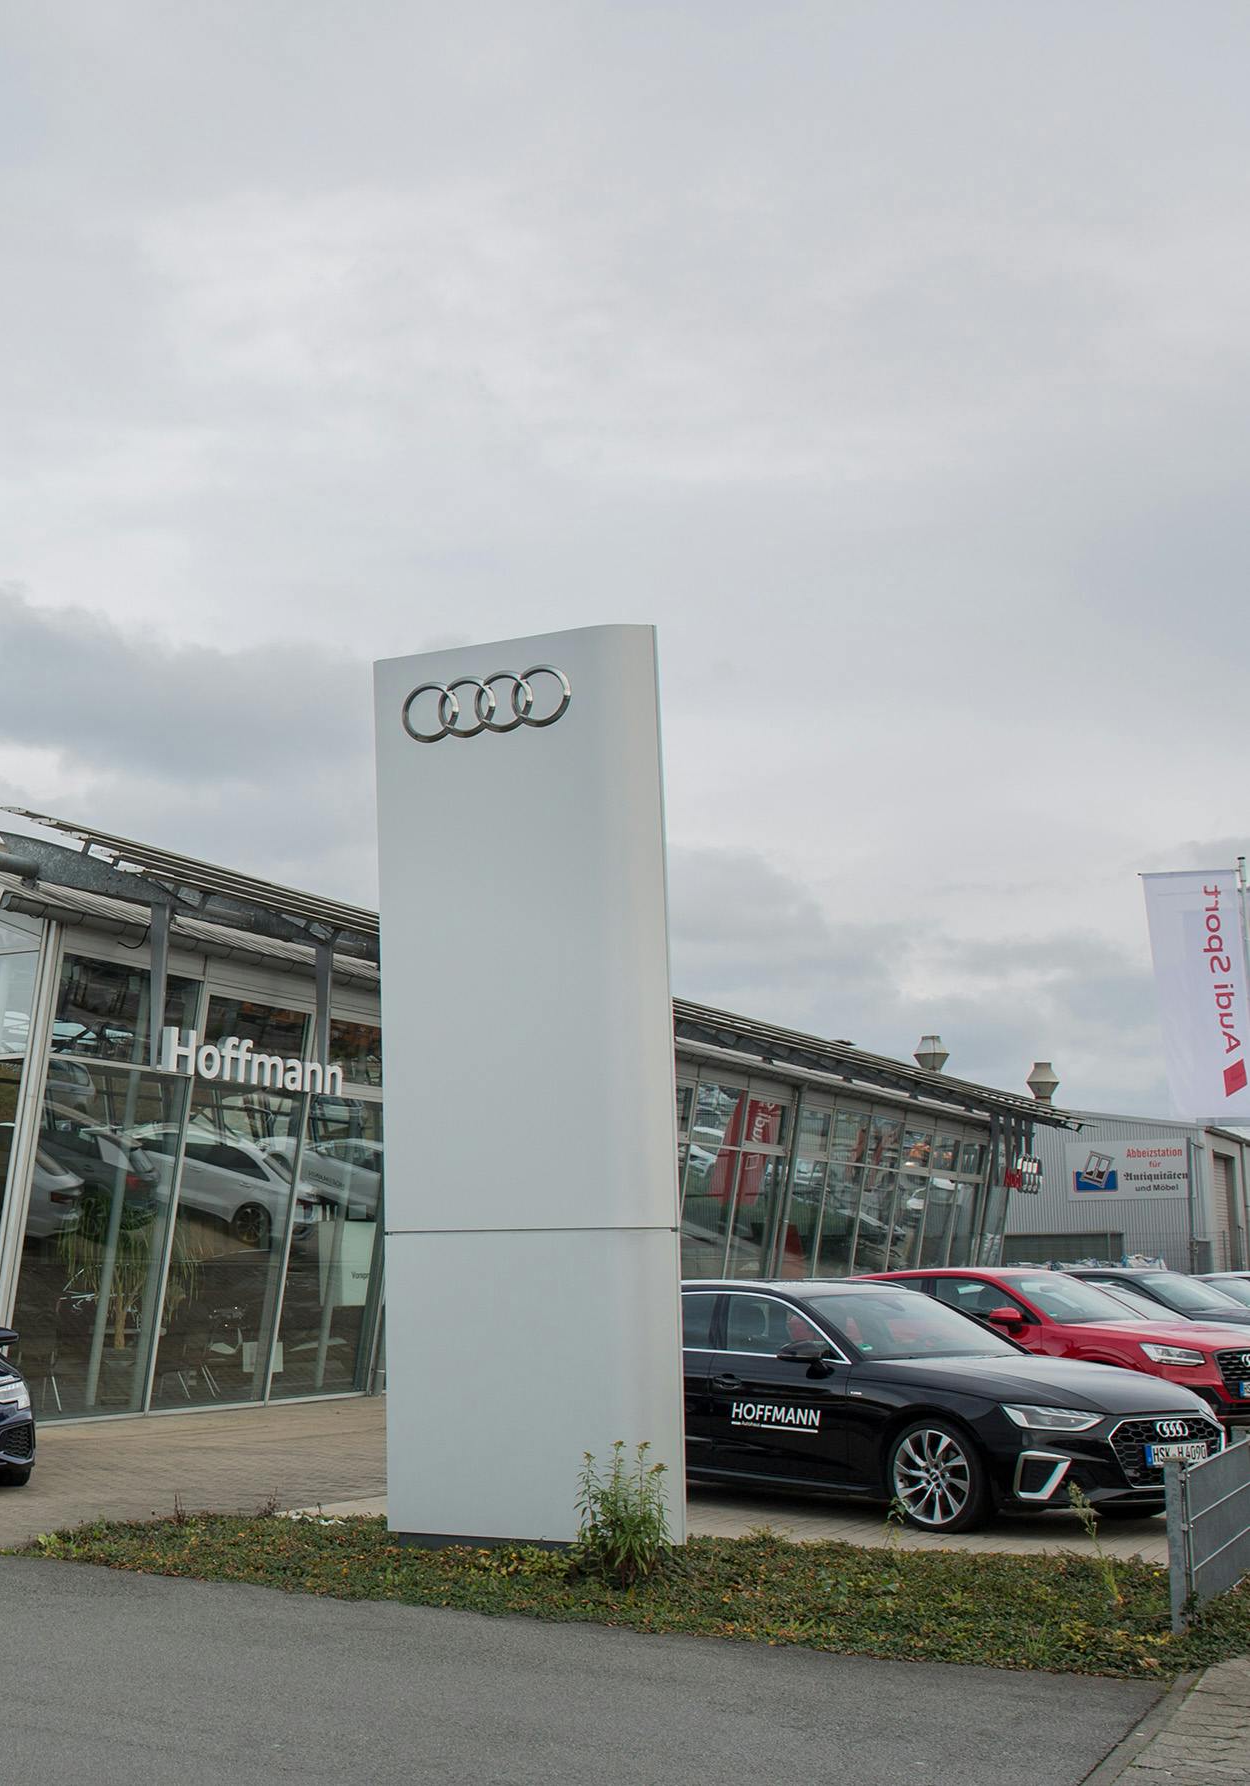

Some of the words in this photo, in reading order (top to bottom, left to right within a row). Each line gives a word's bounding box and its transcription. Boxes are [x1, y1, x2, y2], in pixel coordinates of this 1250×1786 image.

[161, 1027, 343, 1096] Hoffmann
[1126, 1148, 1183, 1159] Abbeizstation
[1123, 1171, 1188, 1182] Antiquitäten
[1153, 1183, 1179, 1192] Möbel
[731, 1402, 821, 1427] HOFFMANN
